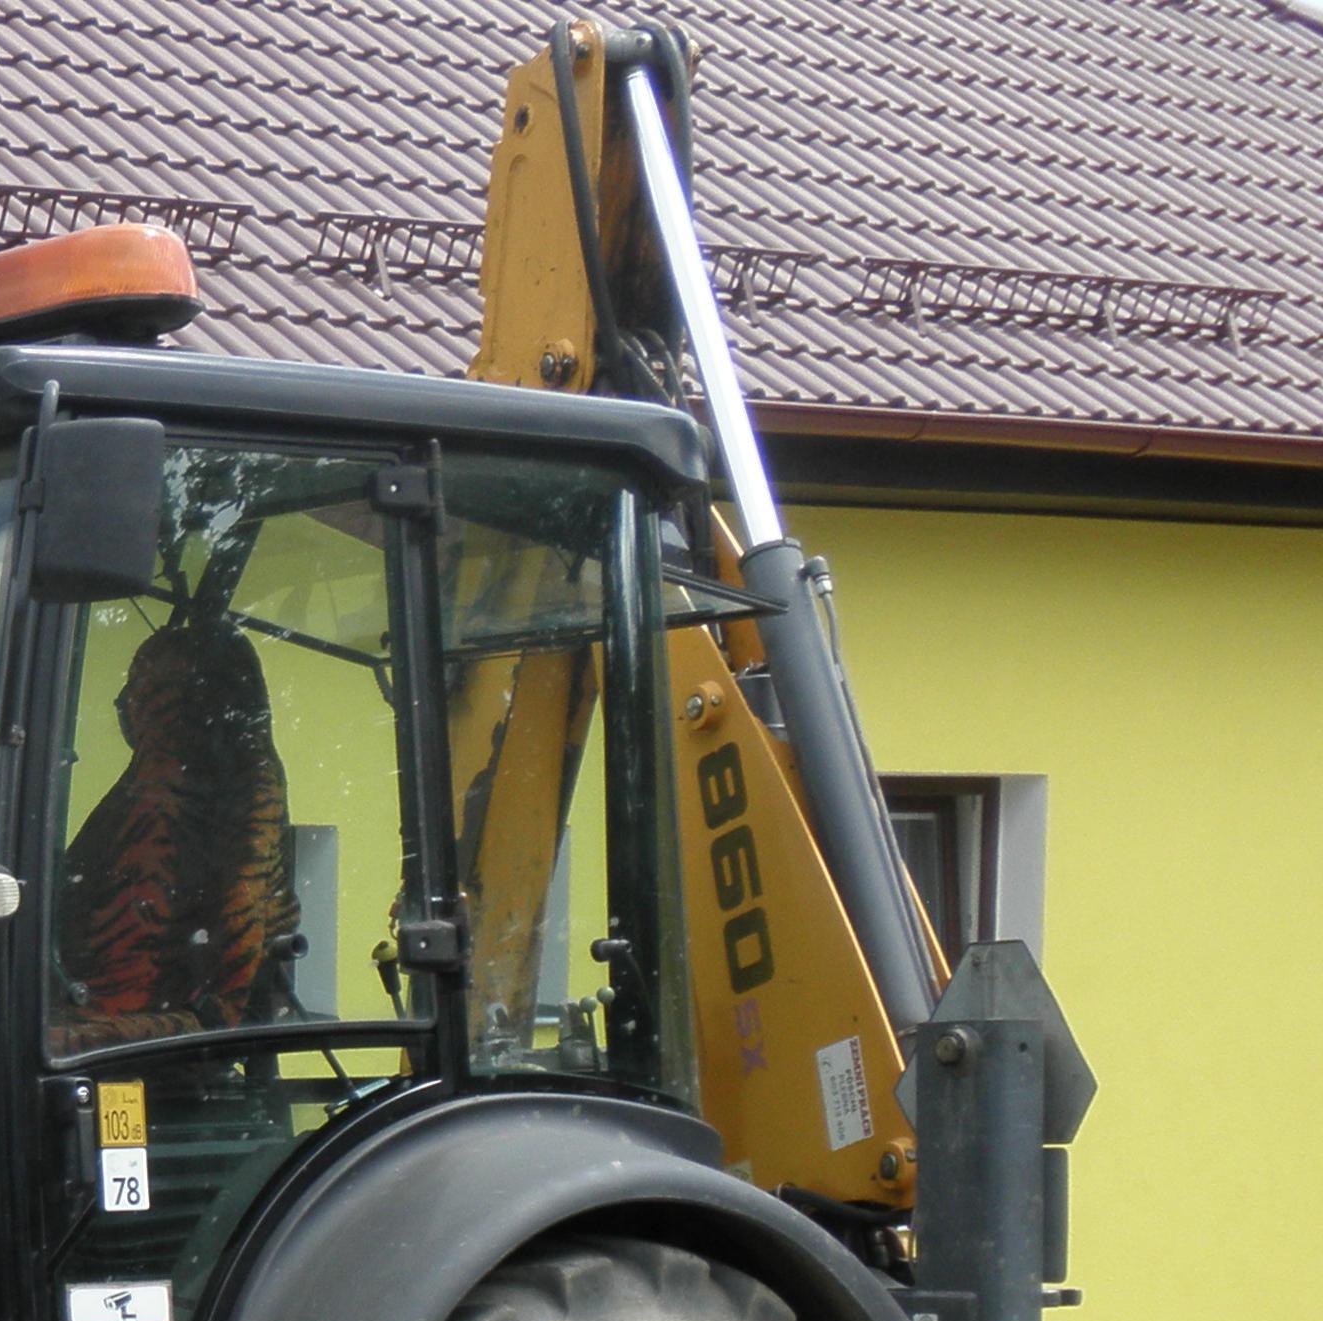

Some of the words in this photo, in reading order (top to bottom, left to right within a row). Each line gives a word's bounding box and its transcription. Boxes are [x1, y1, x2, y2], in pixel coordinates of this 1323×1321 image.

[697, 741, 775, 995] 860
[104, 1110, 129, 1140] 103
[112, 1177, 140, 1206] 78
